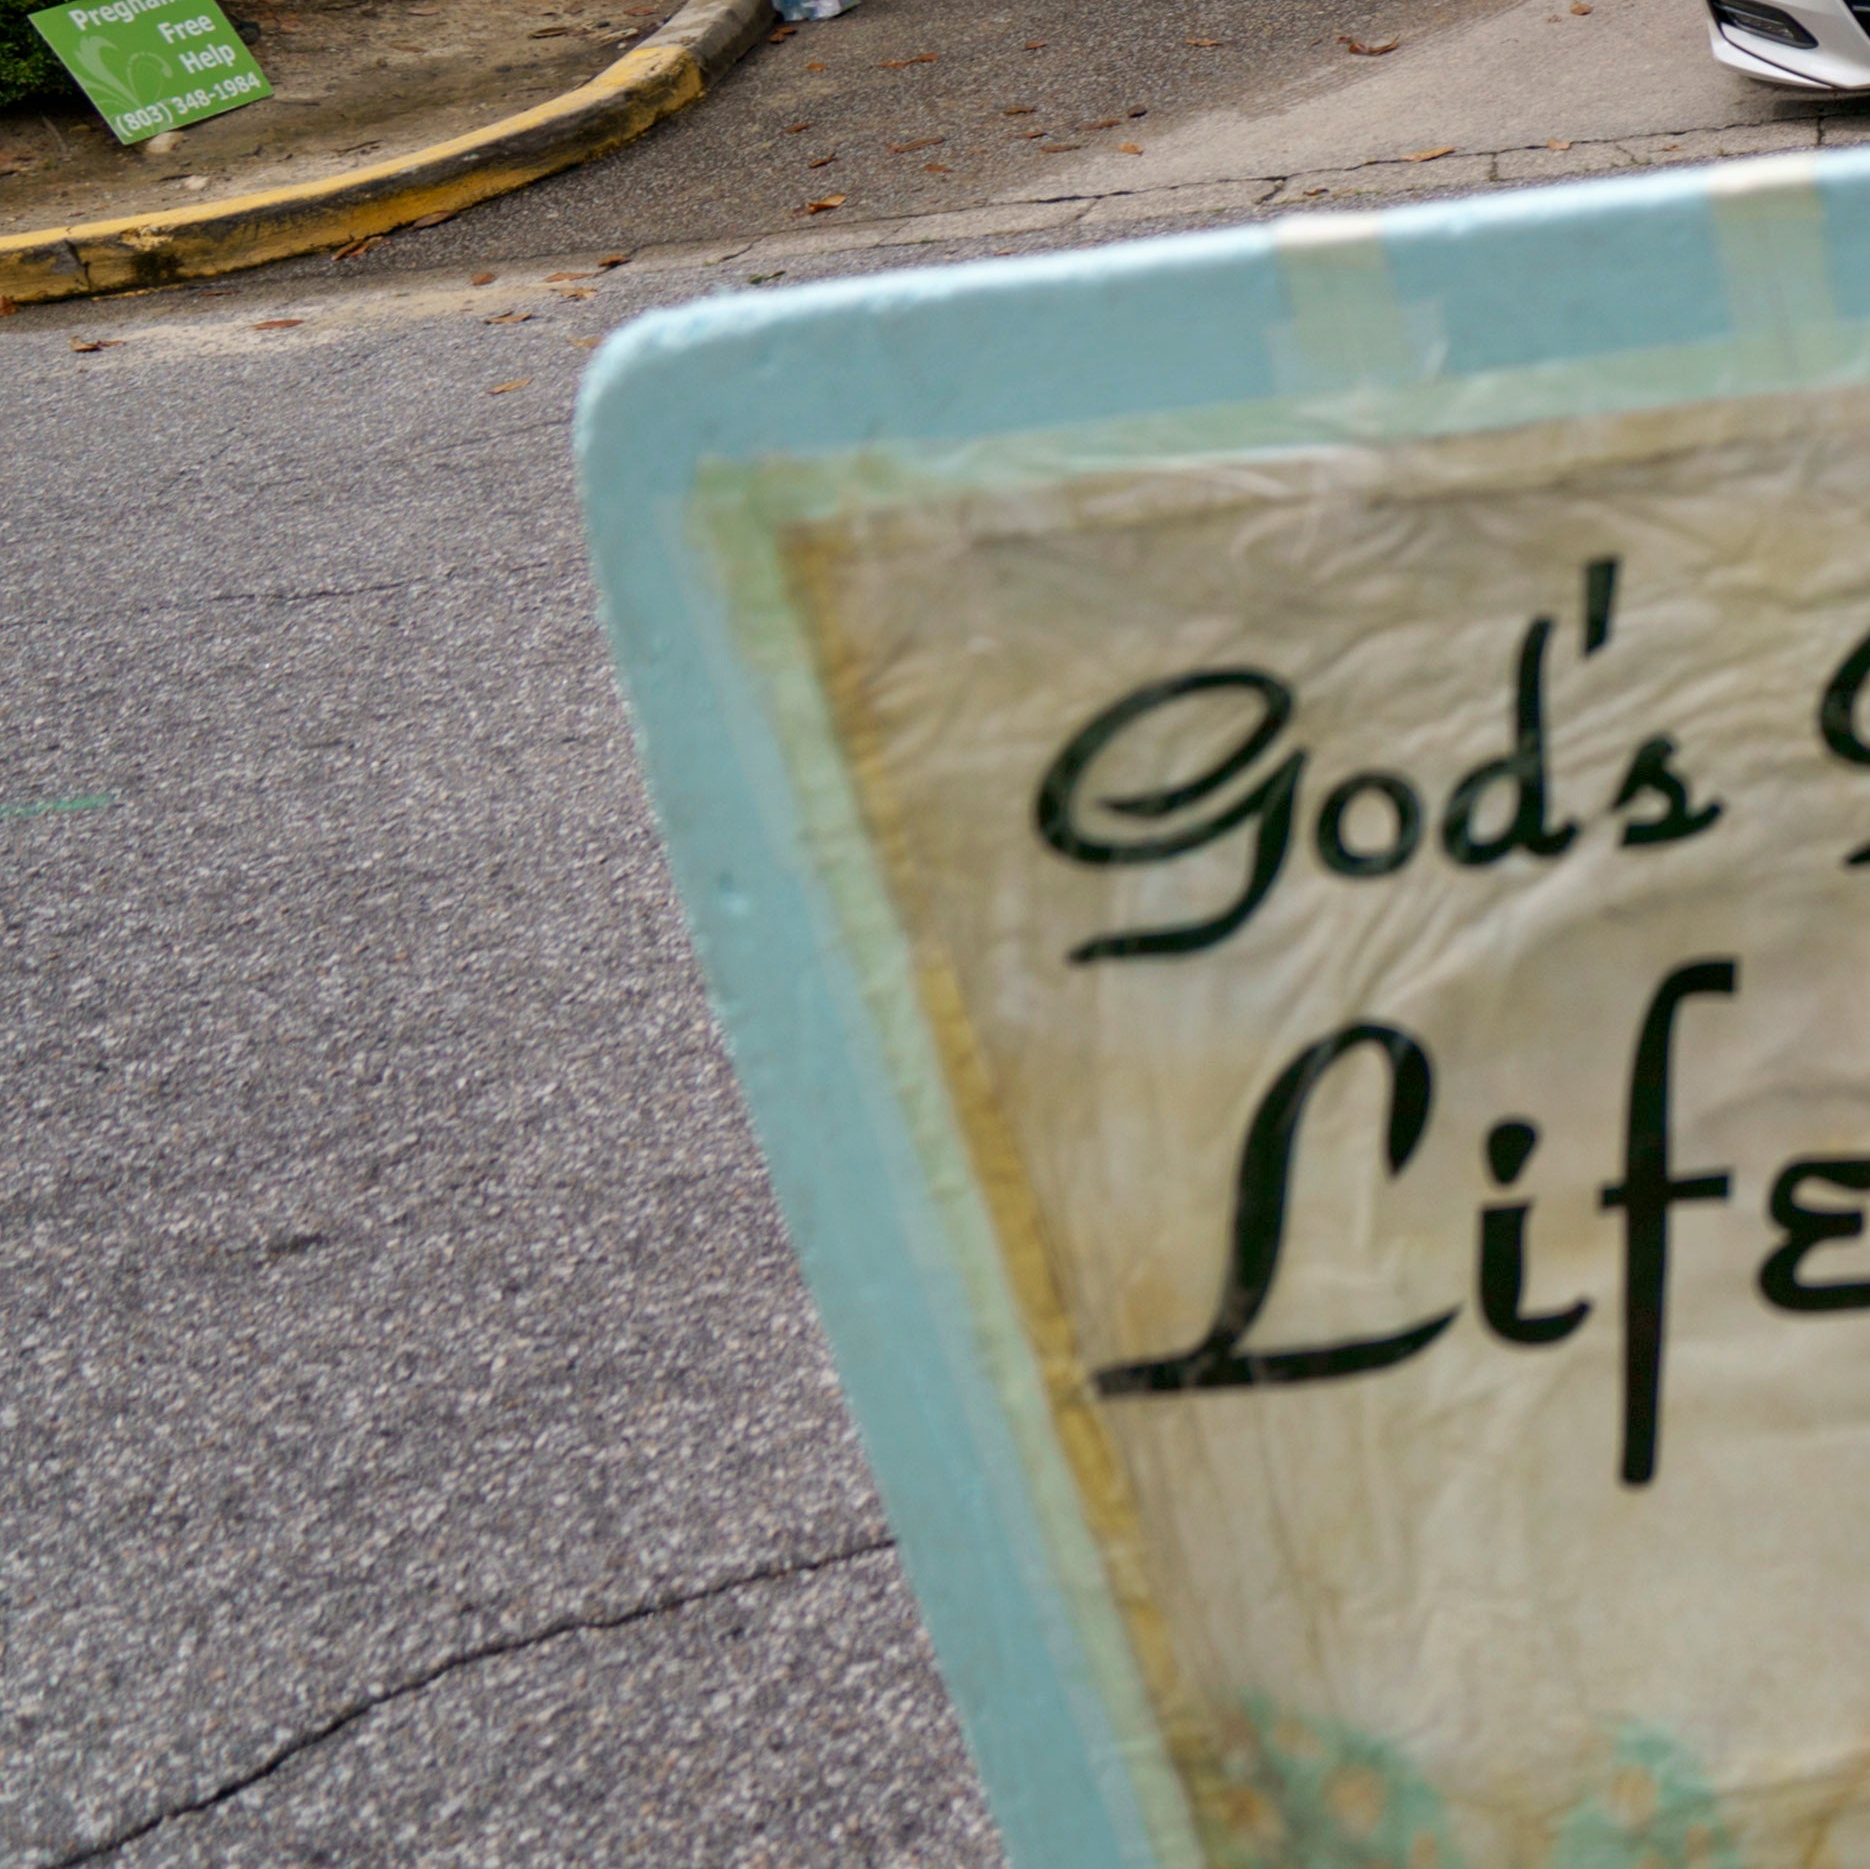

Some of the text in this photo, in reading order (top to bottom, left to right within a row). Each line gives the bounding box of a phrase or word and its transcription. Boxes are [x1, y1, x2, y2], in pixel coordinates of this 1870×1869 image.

[157, 15, 217, 45] Free
[178, 43, 236, 75] Help
[115, 72, 262, 138] (803) 348-1984
[1035, 557, 1727, 963] God's
